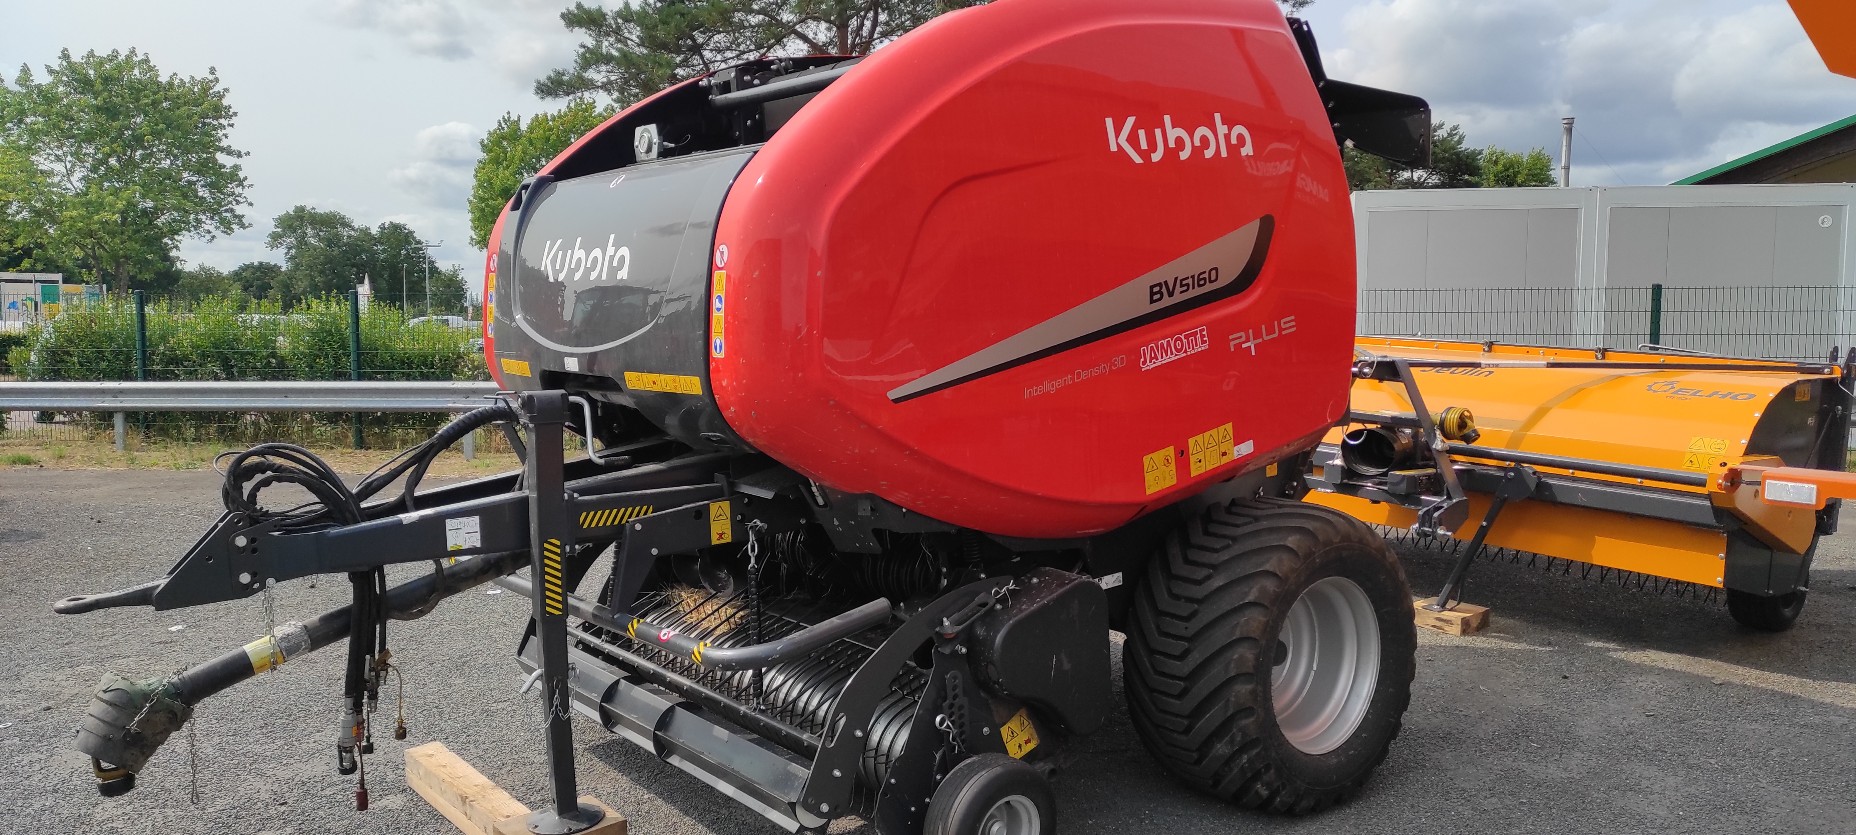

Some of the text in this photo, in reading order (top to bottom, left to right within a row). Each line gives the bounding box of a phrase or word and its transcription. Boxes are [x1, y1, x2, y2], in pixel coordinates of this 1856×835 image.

[1105, 112, 1254, 164] Kubota
[540, 233, 630, 283] Kubota
[1149, 266, 1219, 305] BV5160
[1140, 326, 1209, 368] JAMOTTE
[1229, 315, 1297, 356] PLUS
[1024, 374, 1073, 399] Intelligent
[1074, 362, 1110, 382] Density
[1111, 355, 1127, 370] 3D
[1671, 387, 1757, 401] ELHO
